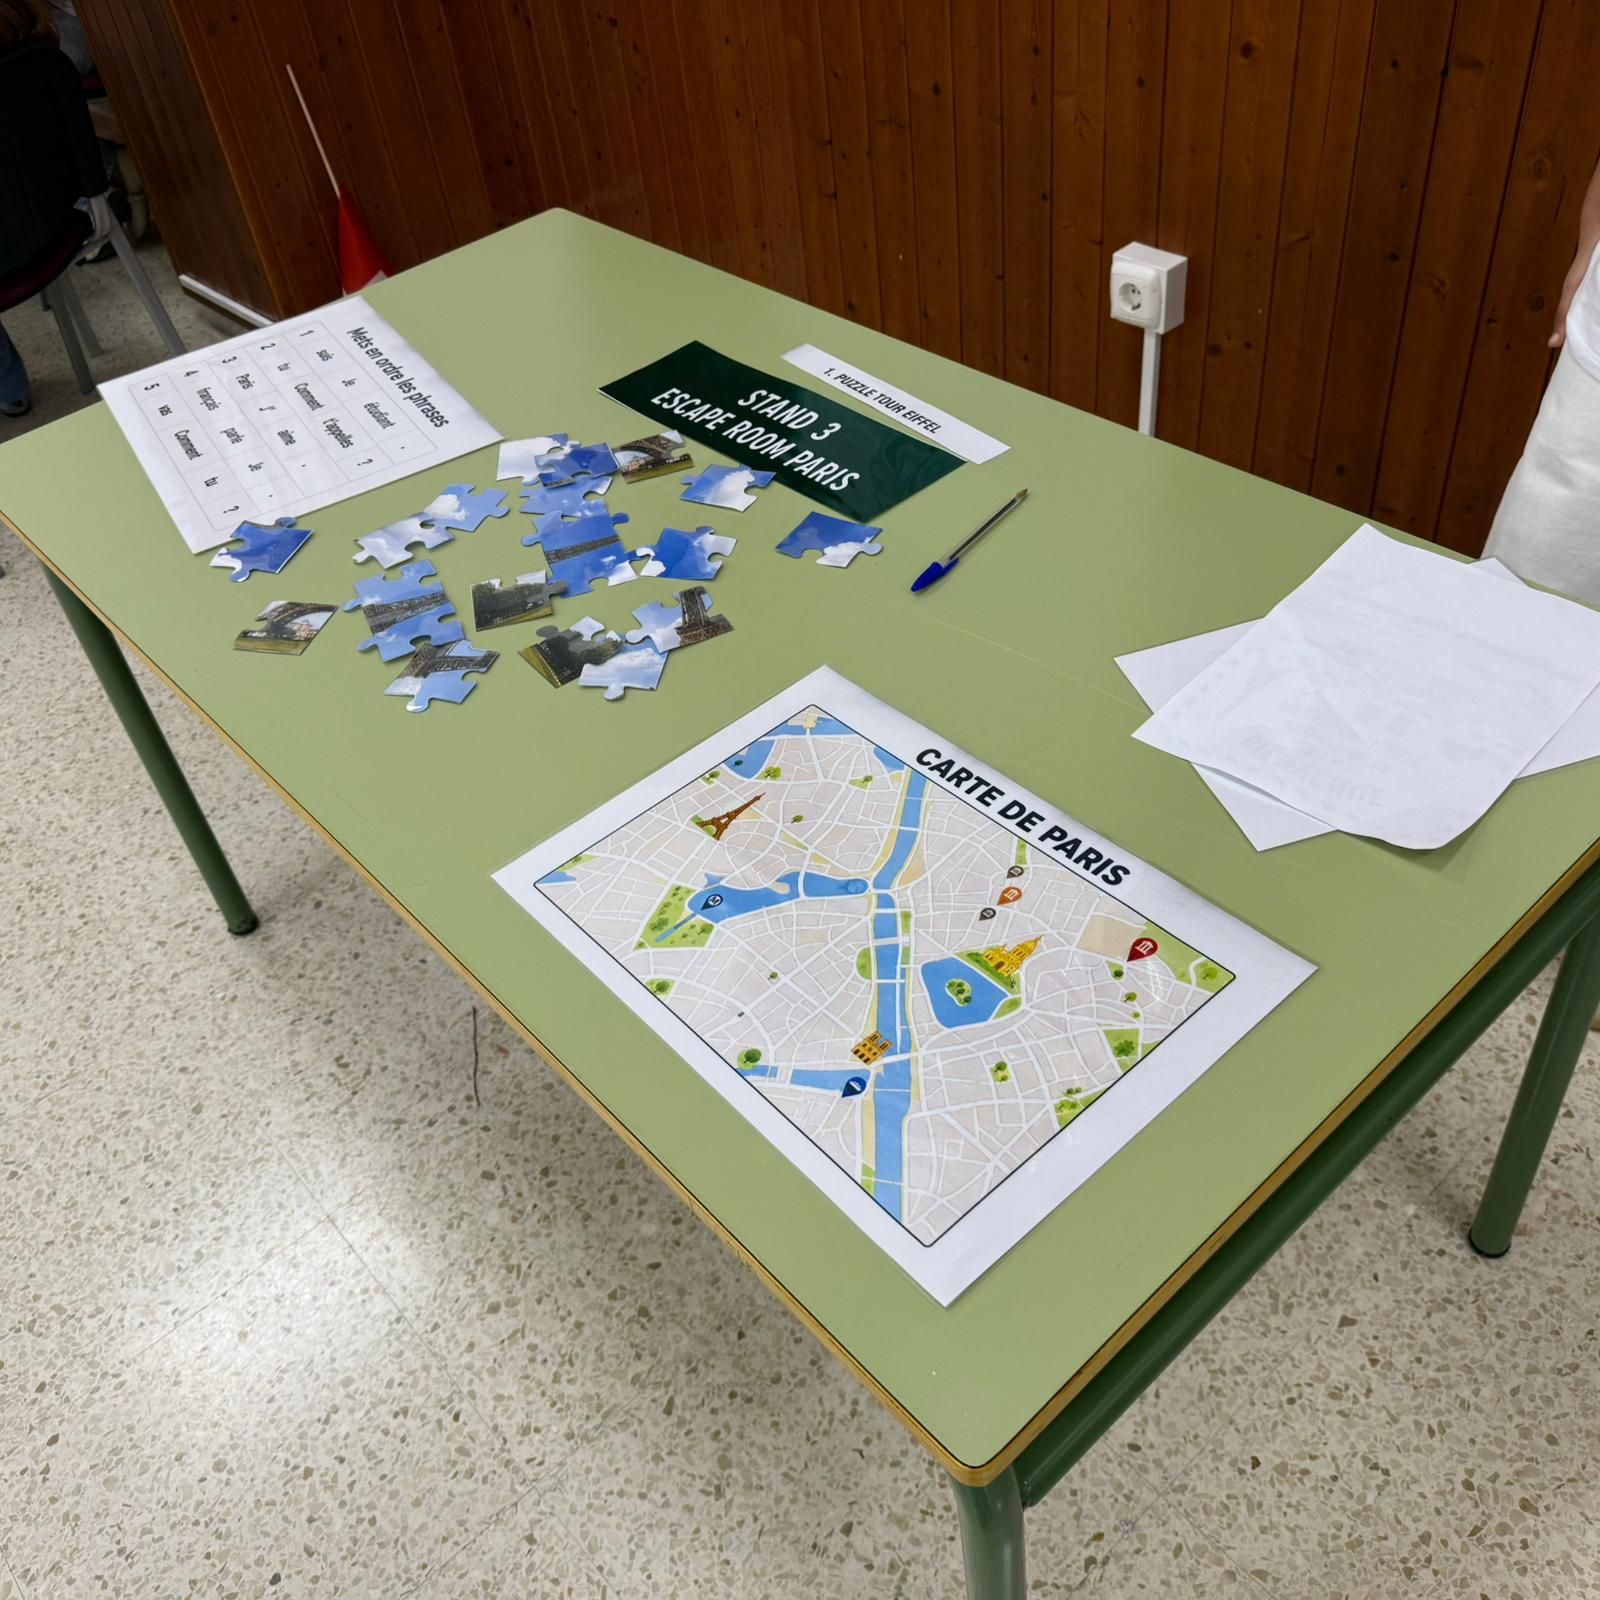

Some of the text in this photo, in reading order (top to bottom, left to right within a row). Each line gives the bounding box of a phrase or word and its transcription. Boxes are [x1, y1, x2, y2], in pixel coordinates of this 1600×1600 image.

[183, 370, 199, 378] 4
[196, 386, 222, 412] français
[219, 427, 245, 445] parle
[247, 461, 264, 472] Je
[221, 356, 238, 364] 3
[235, 373, 256, 390] Paris
[277, 429, 297, 447] aime
[260, 342, 374, 467] 2 tu Comment t'appelles ?
[299, 329, 315, 337] 1
[315, 349, 335, 362] suis
[341, 378, 357, 388] Je
[363, 401, 396, 430] étudiant
[347, 327, 449, 427] Mets en ordre les phrases
[738, 390, 841, 440] STAND 3
[823, 367, 941, 434] 1. PUZZLE TOUR EIFFEL
[143, 383, 240, 514] 5 vas Comment tu ?
[651, 389, 860, 490] ESCAPE ROOM PARIS
[916, 749, 1130, 885] CARTE DE PARIS
